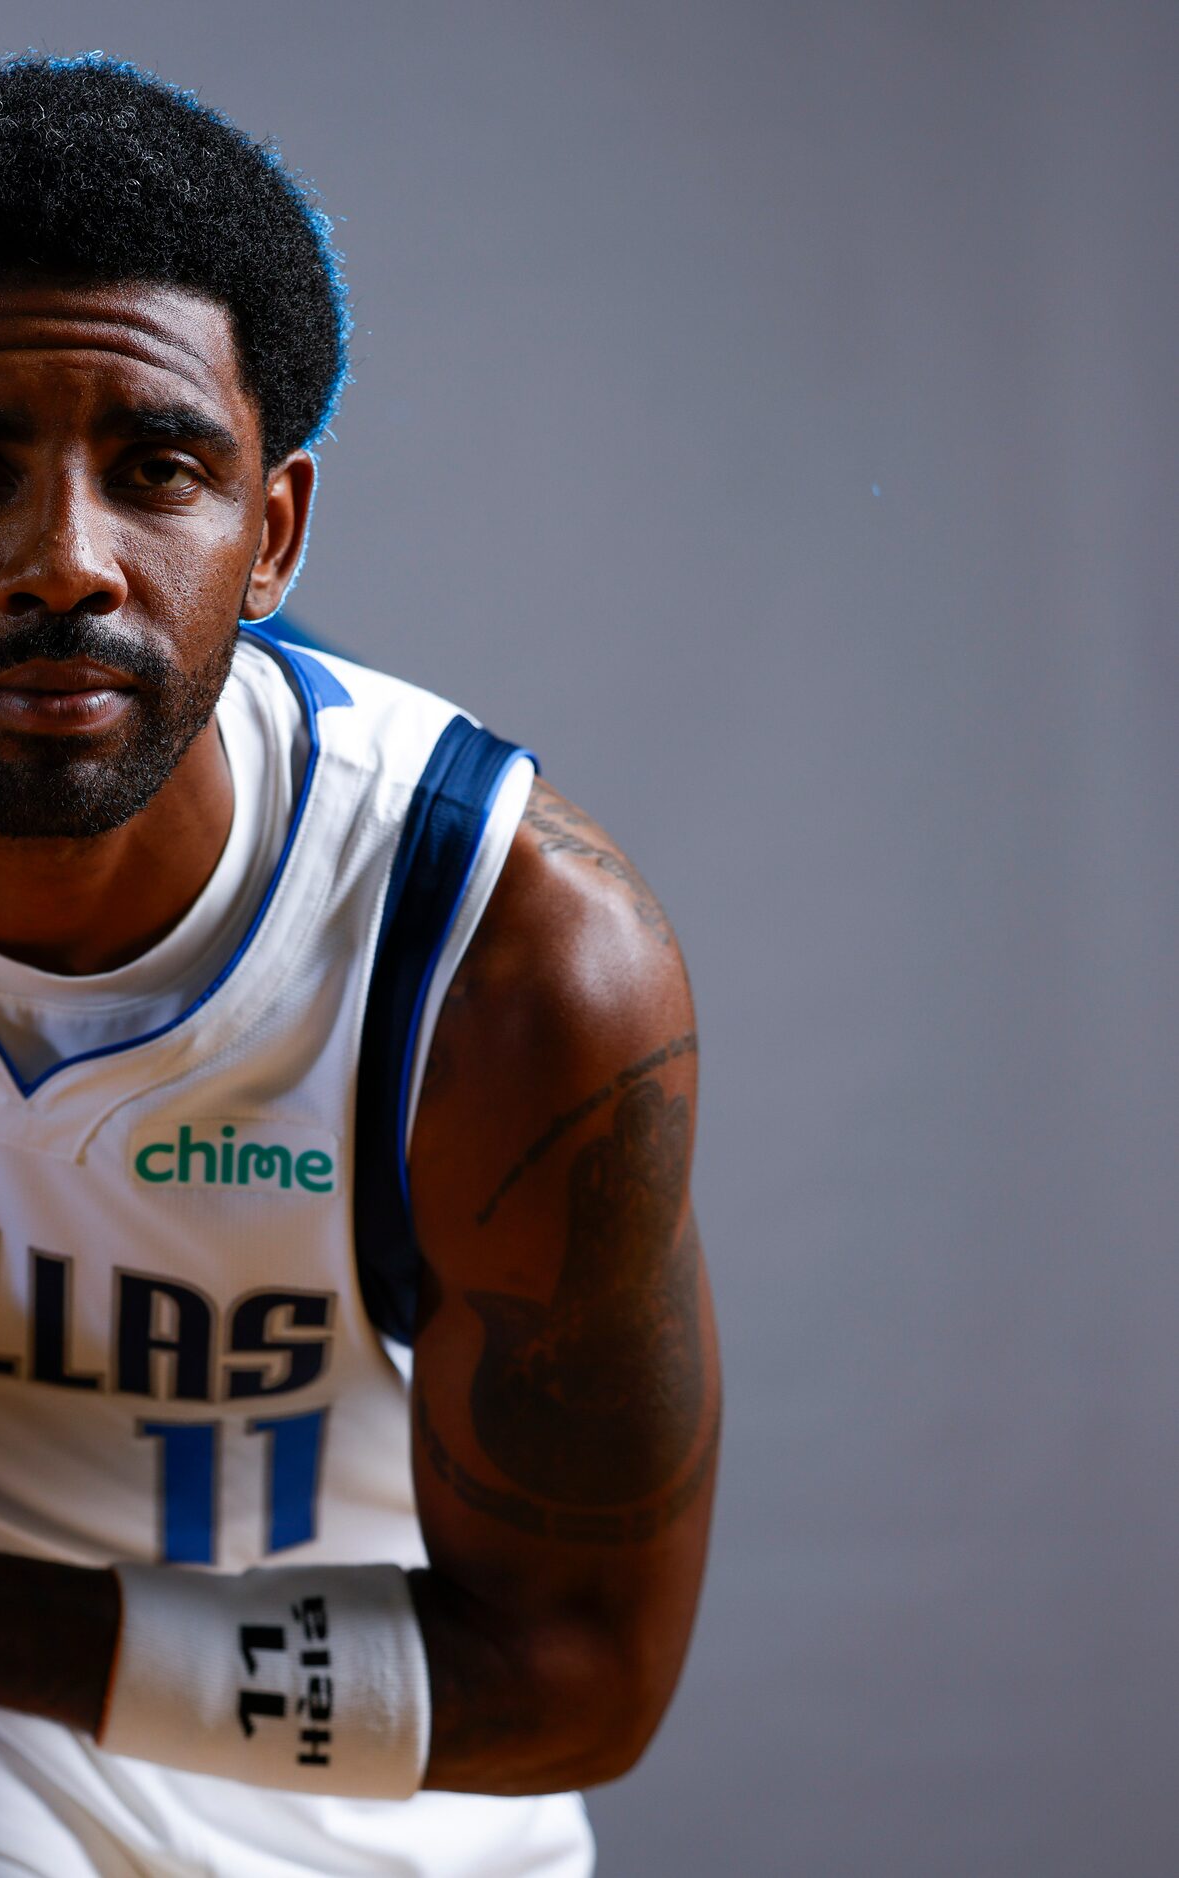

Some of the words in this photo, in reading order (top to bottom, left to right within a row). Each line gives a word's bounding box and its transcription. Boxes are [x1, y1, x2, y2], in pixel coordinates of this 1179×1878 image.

[135, 1125, 334, 1192] chime
[136, 1406, 329, 1567] 11
[238, 1624, 288, 1739] 11
